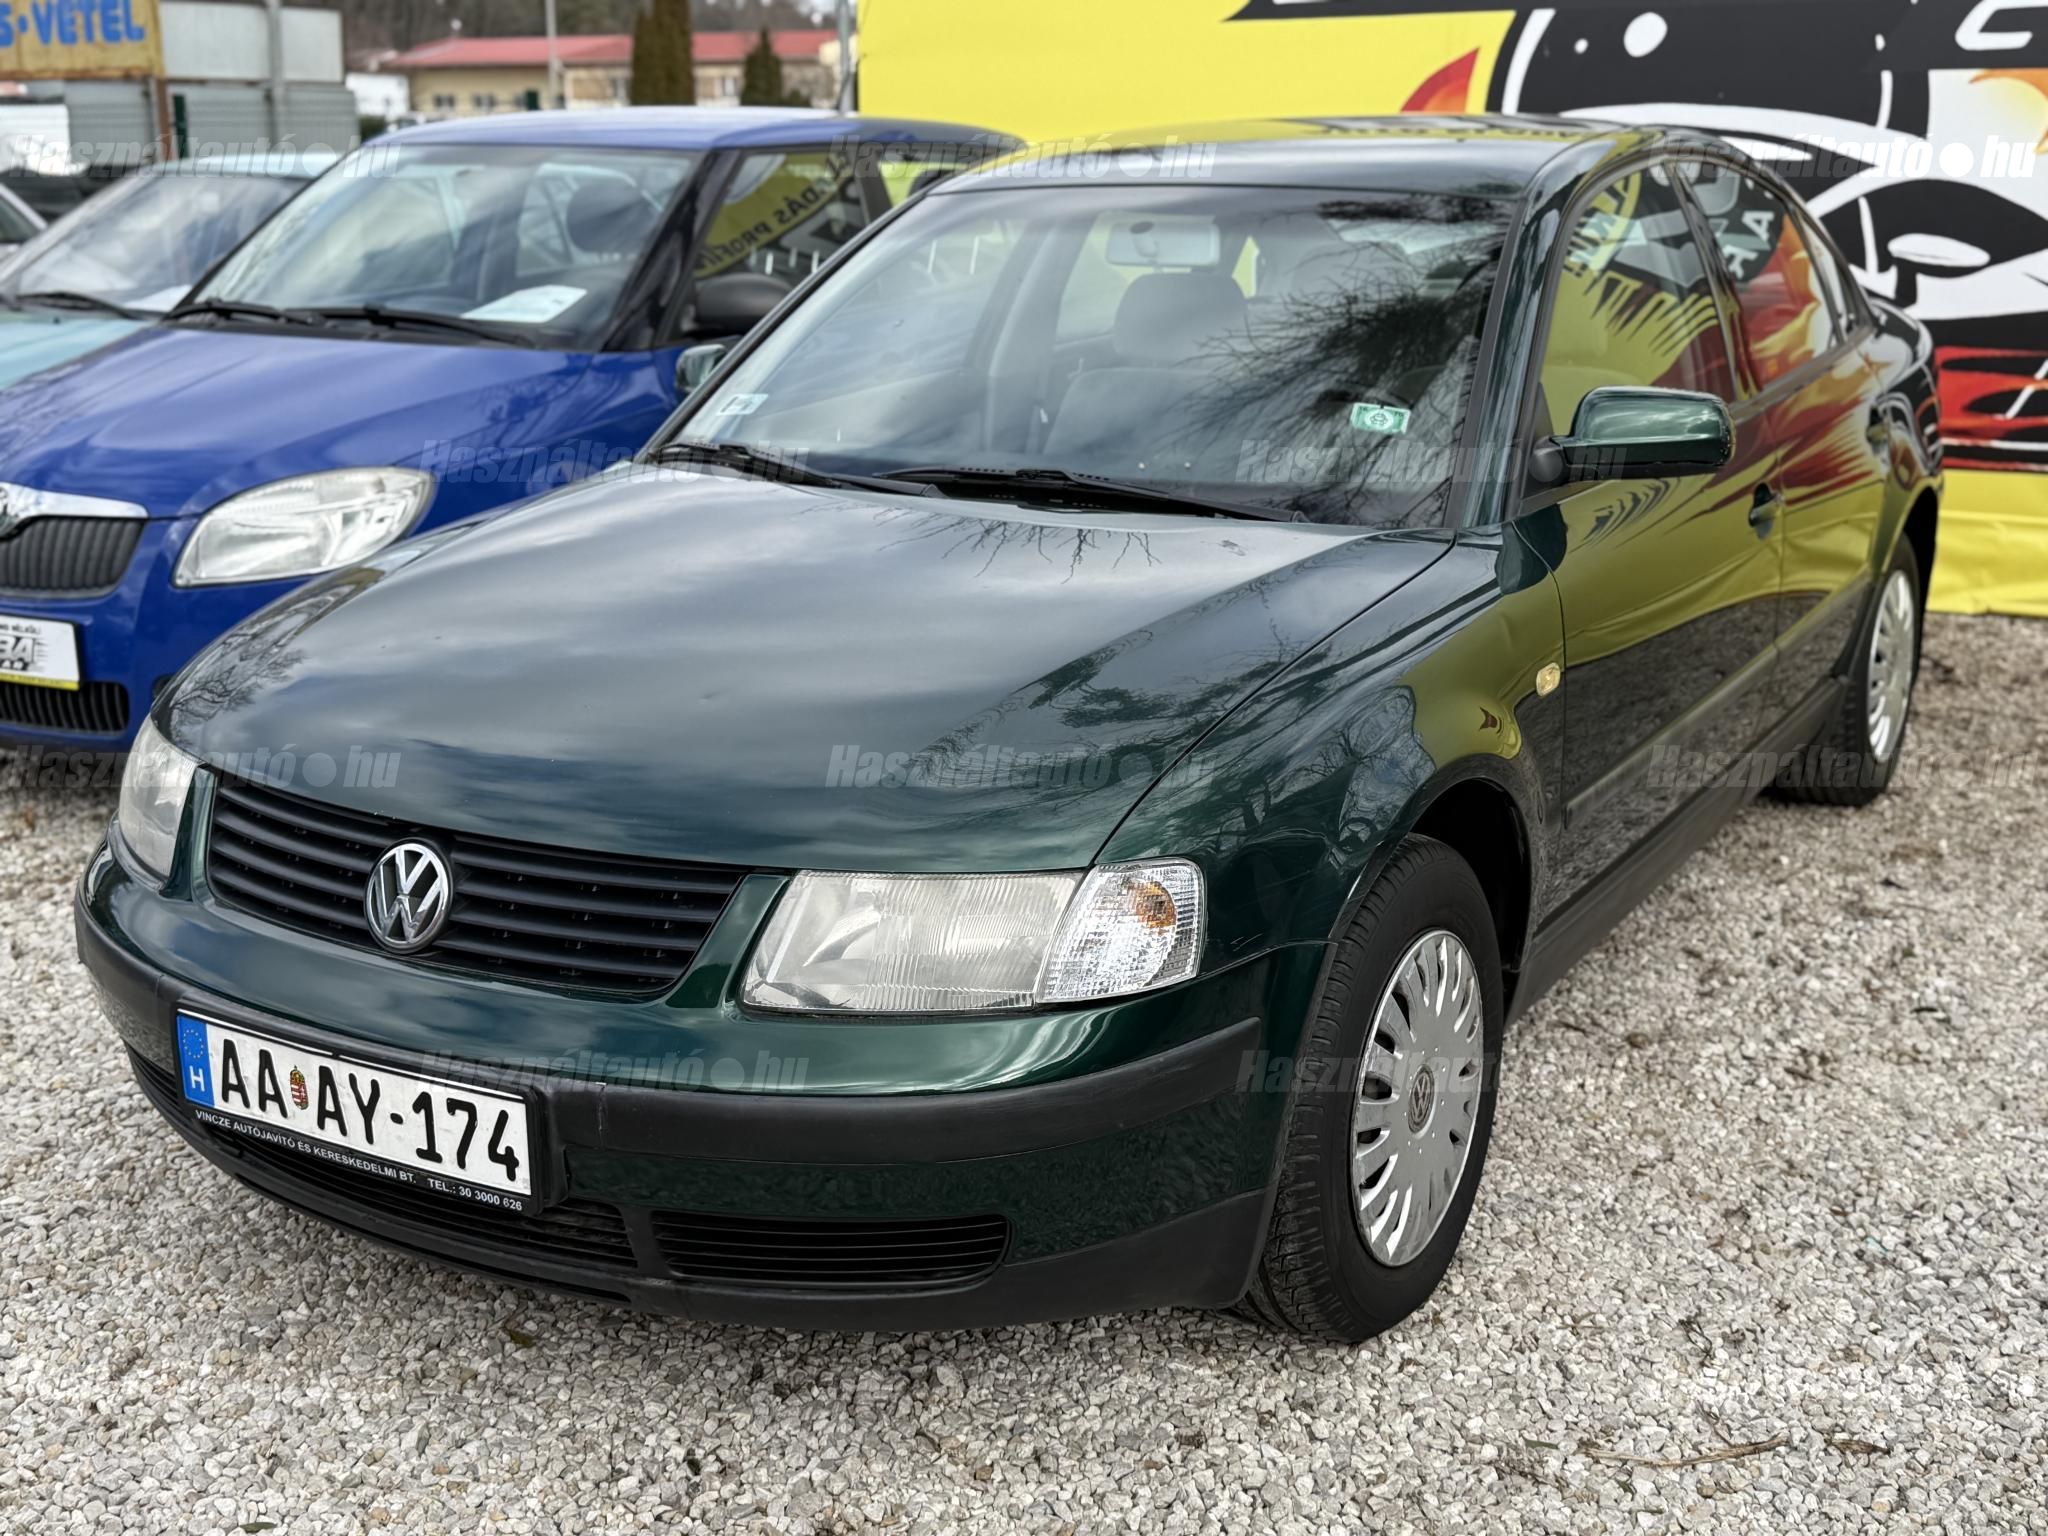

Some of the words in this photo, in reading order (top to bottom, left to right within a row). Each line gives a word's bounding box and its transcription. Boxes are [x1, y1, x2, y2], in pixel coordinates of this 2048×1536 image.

[189, 1065, 206, 1092] H
[222, 1038, 288, 1118] AA
[317, 1065, 520, 1182] AY-174
[195, 1109, 231, 1129] VINCZE
[233, 1122, 296, 1148] AUTÓJAVÍTÓ
[298, 1140, 312, 1153] ÉS
[313, 1145, 397, 1178] KERESKEDELMI
[400, 1171, 417, 1184] BT.
[459, 1185, 472, 1198] 30
[475, 1190, 501, 1205] 3000
[503, 1198, 522, 1211] 626
